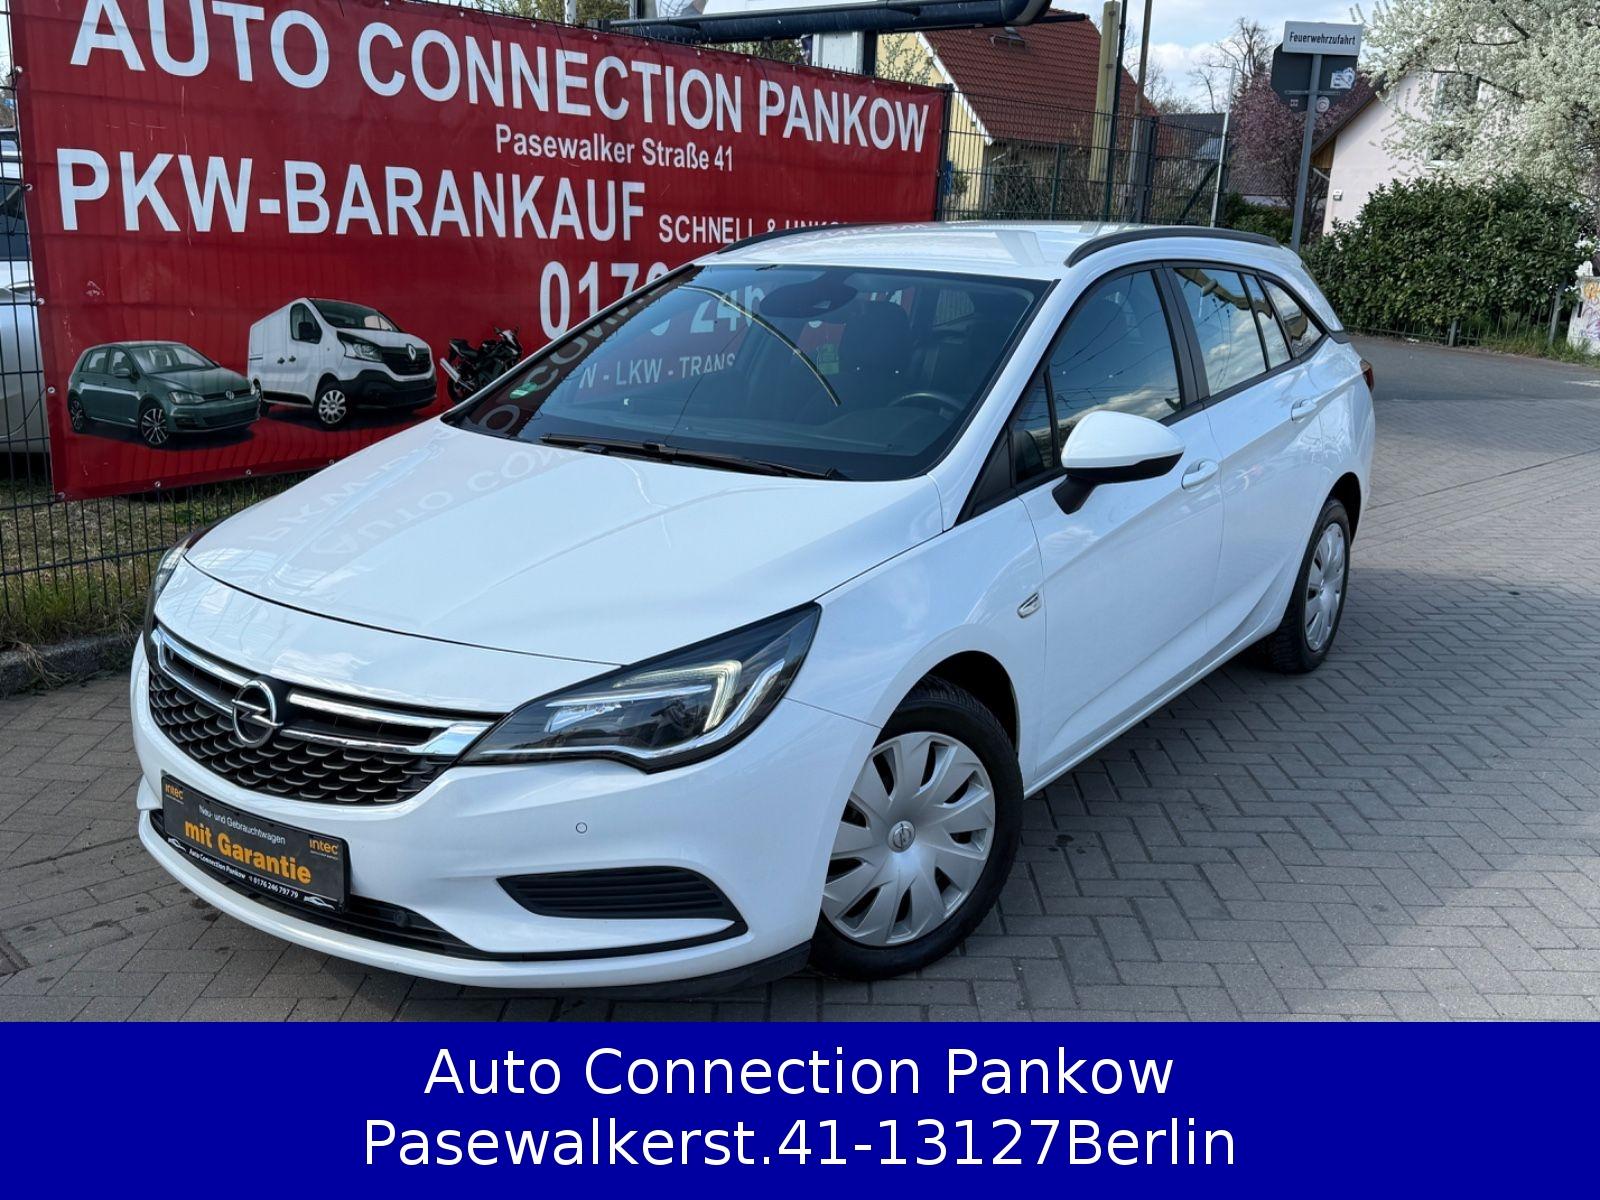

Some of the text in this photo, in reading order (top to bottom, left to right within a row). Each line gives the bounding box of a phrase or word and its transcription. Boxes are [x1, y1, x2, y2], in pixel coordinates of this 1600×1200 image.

[1289, 31, 1356, 46] Feuerwehrzufahrt
[70, 0, 930, 153] AUTO CONNECTION PANKOW
[495, 124, 734, 172] Pasewalker Straße 41
[56, 148, 646, 242] PKW-BARANKAUF
[616, 358, 663, 385] LKW
[184, 820, 312, 885] mit Garantie
[309, 839, 338, 855] intec
